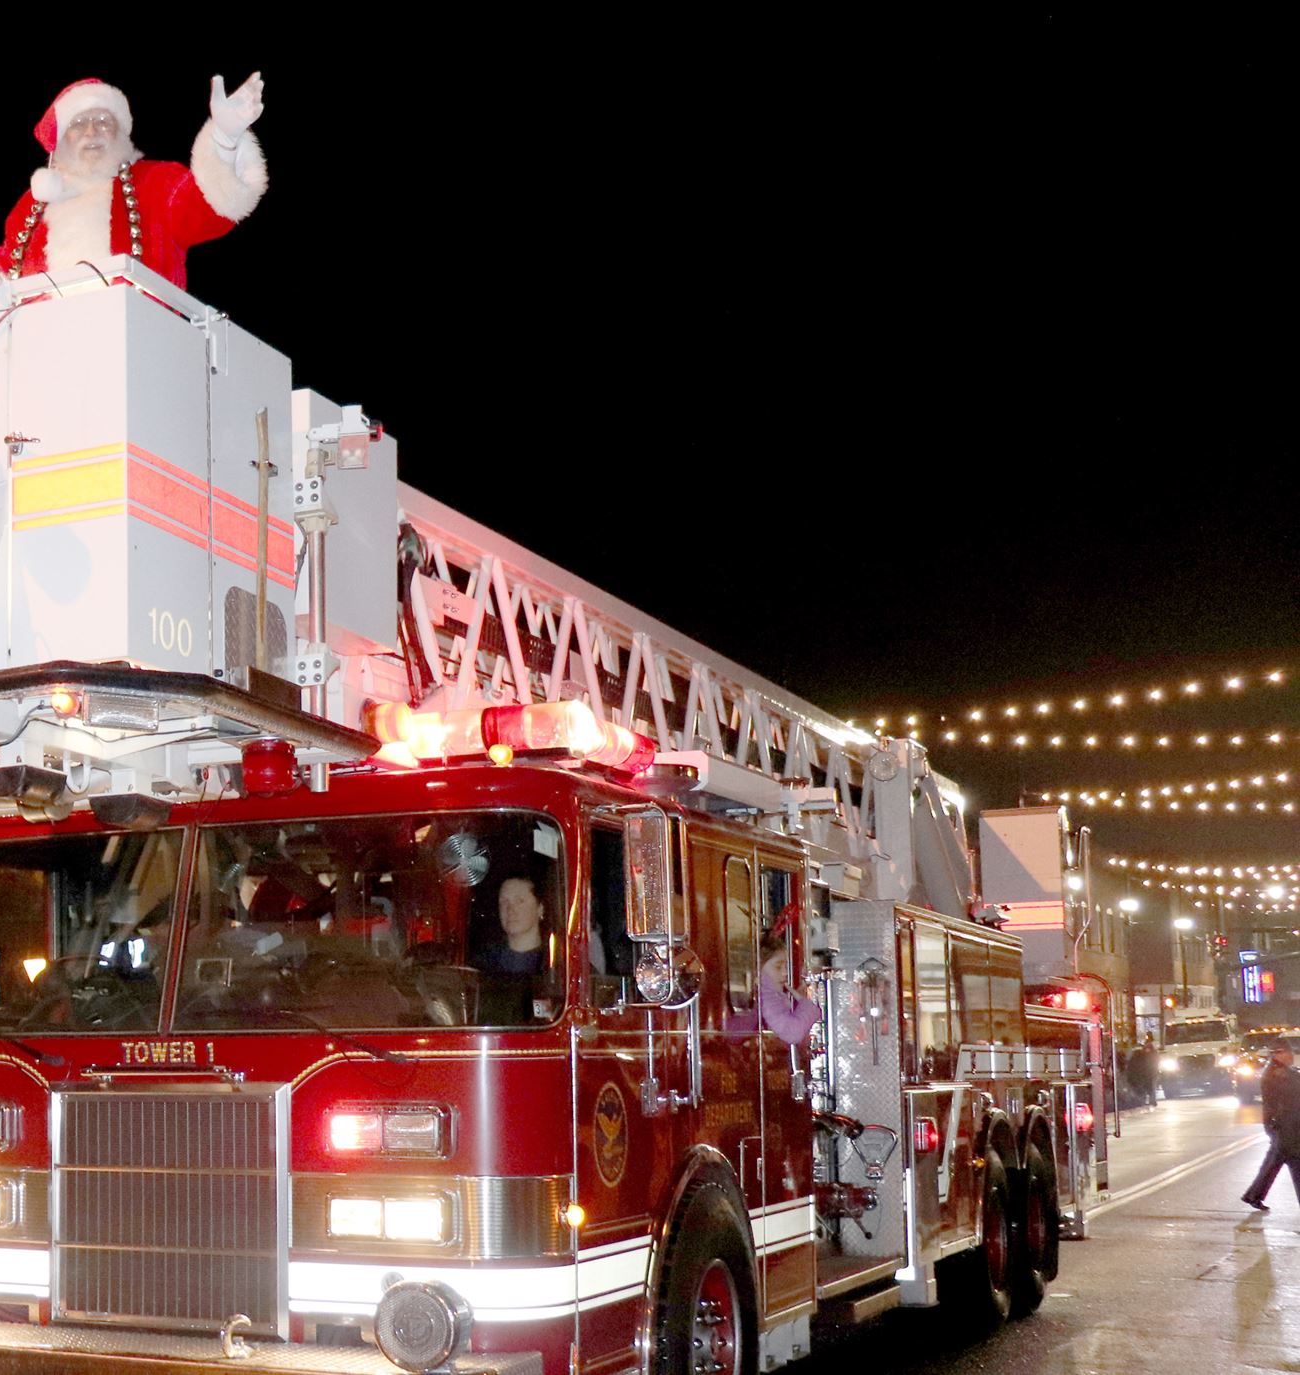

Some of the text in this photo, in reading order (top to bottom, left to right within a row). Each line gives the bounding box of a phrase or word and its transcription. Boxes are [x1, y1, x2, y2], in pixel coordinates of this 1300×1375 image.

[147, 607, 192, 657] 100
[121, 1041, 214, 1063] TOWER 1
